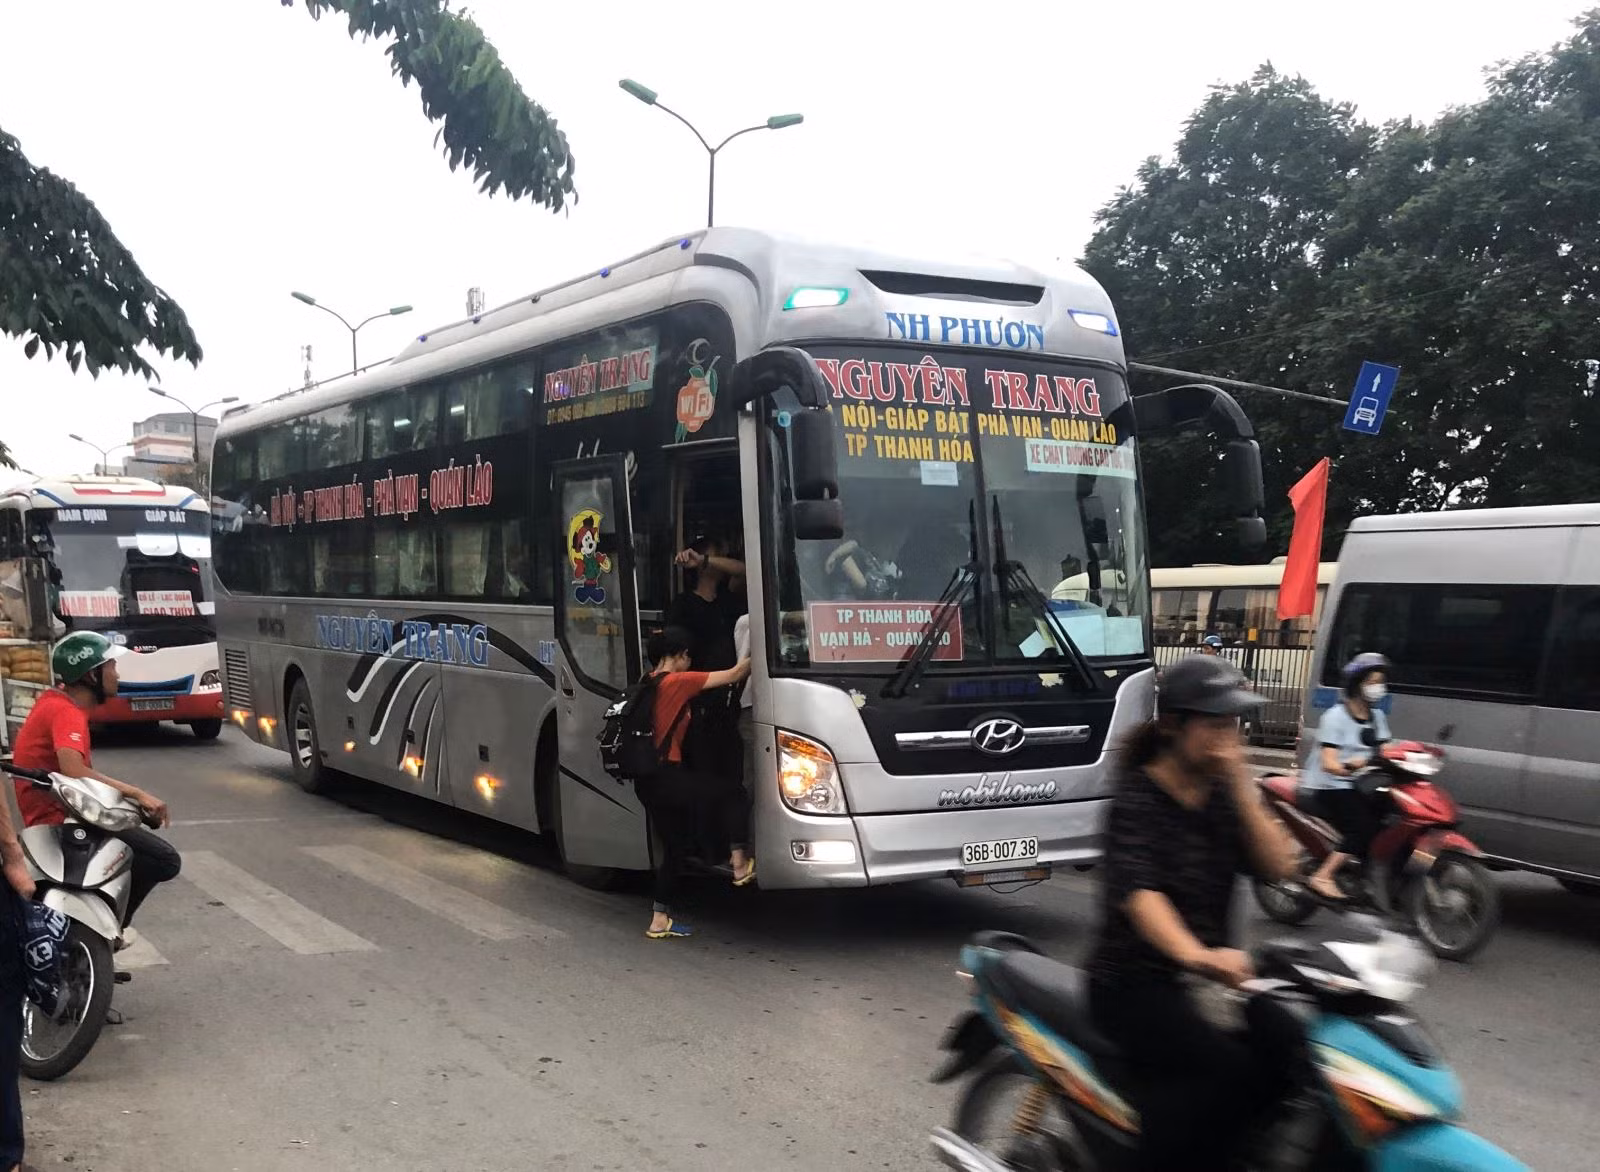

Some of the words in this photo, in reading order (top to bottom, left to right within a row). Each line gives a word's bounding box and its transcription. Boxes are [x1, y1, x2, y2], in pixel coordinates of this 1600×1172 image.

[886, 312, 931, 341] NH
[599, 350, 650, 392] TRANG
[985, 369, 1101, 416] TRANG
[935, 407, 970, 433] BÁT
[977, 410, 1009, 437] PHÀ
[1092, 418, 1117, 444] LÀO
[845, 434, 868, 457] TP
[874, 435, 934, 460] THANH
[939, 434, 974, 463] HÓA
[1031, 444, 1041, 464] XE
[1094, 448, 1109, 467] CAO
[304, 490, 314, 523] TP
[315, 485, 343, 522] THANH
[344, 473, 364, 519] HÓA
[374, 469, 395, 516] PHÀ
[396, 473, 418, 521] VẠN
[430, 458, 464, 514] QUÁN
[466, 454, 493, 506] LÀO
[57, 509, 81, 521] NAM
[83, 509, 107, 523] ĐỊNH
[145, 508, 167, 522] GIÁP
[169, 508, 186, 523] BÁT
[61, 595, 87, 616] NAM
[837, 609, 853, 624] TP
[858, 609, 902, 624] THANH
[906, 606, 933, 624] HÓA
[316, 610, 395, 655] NGUYÊN
[402, 620, 489, 666] TRANG
[819, 631, 849, 649] VẠN
[853, 627, 872, 646] HÀ
[886, 628, 923, 647] QUÁN
[67, 647, 94, 665] Grab
[937, 771, 1057, 807] mobihome
